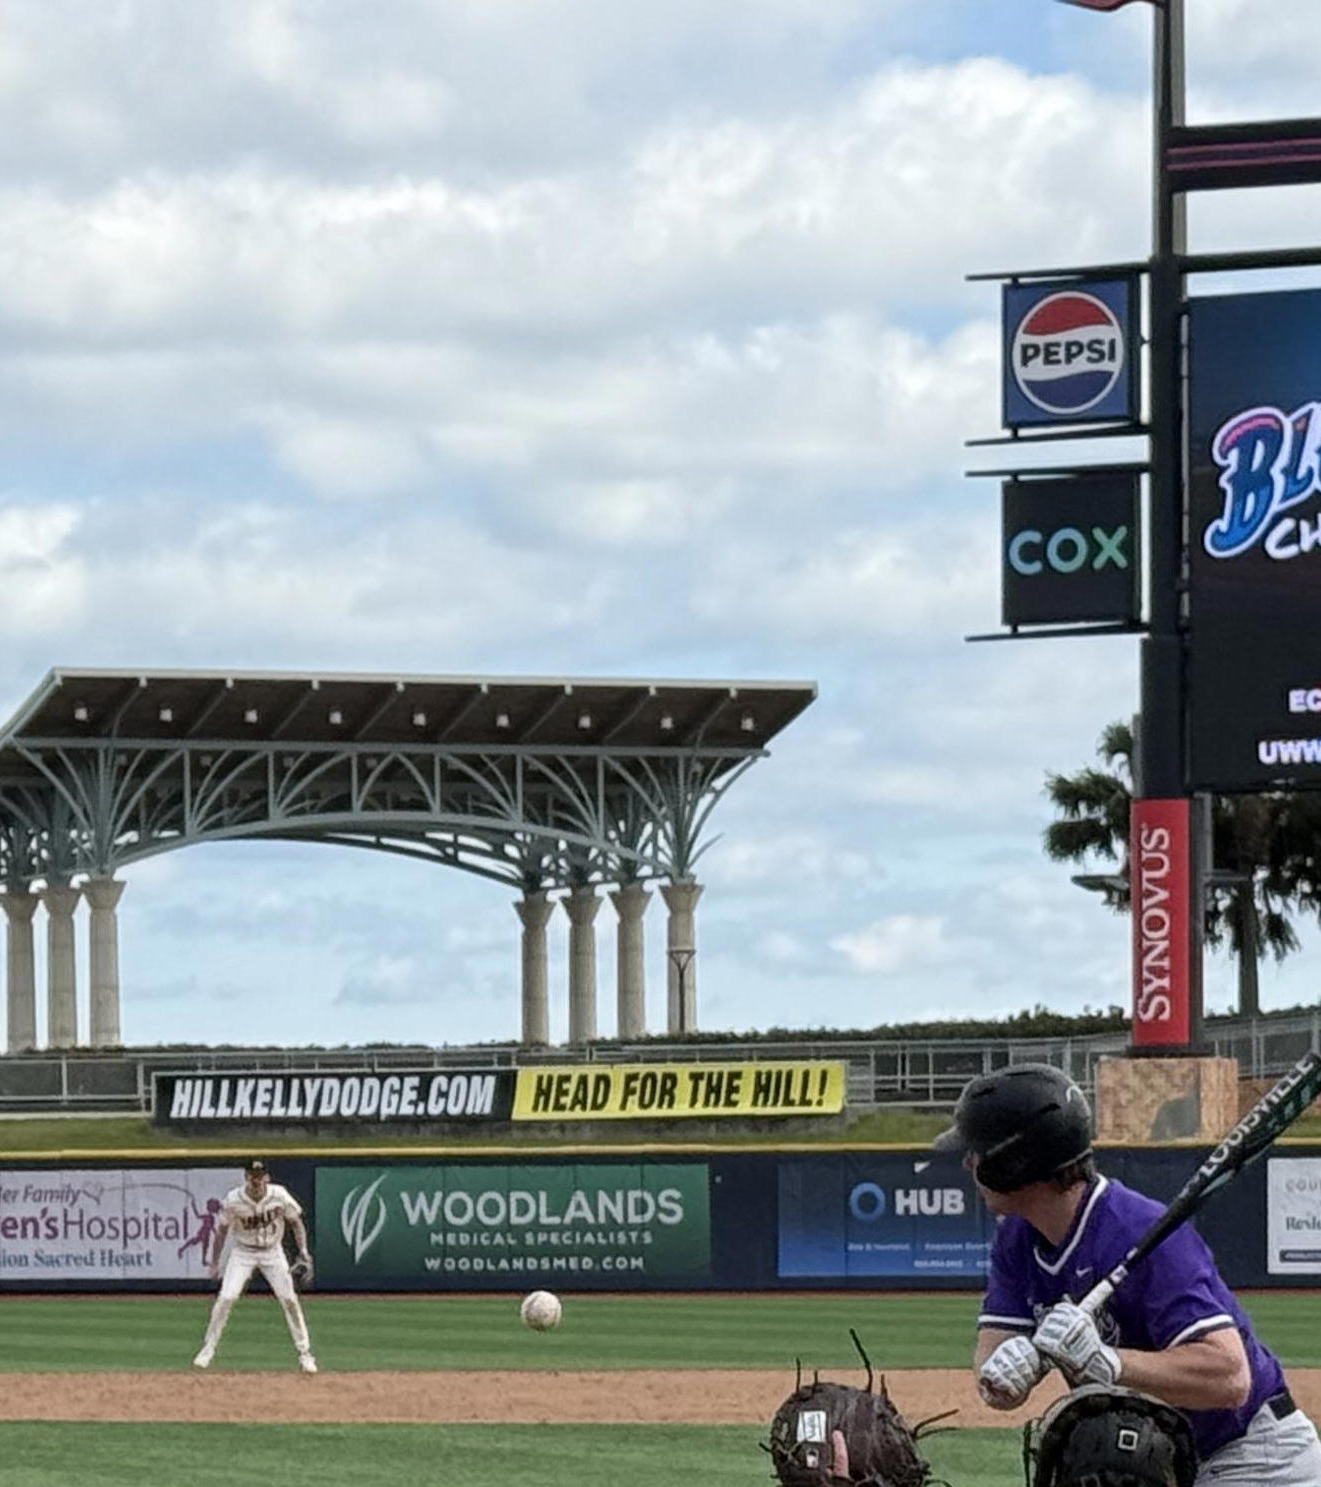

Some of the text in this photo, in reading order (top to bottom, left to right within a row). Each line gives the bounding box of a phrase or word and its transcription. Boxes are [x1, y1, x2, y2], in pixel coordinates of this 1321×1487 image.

[1020, 338, 1117, 367] PEPSI
[1009, 526, 1128, 575] COX
[1138, 826, 1172, 1023] SYNOVUS
[170, 1076, 496, 1118] HILLKELLYDODGE.COM
[531, 1068, 828, 1112] HEAD FOR THE HILL!
[1199, 1061, 1315, 1177] LOUISVILLE
[22, 1185, 80, 1206] Family
[400, 1189, 684, 1226] WOODLANDS
[895, 1189, 965, 1216] HUB
[430, 1231, 653, 1246] MEDICAL SPECIALISTS
[33, 1250, 95, 1267] Sacred
[100, 1249, 153, 1267] Heart
[425, 1256, 644, 1271] WOODLANDSMED.COM
